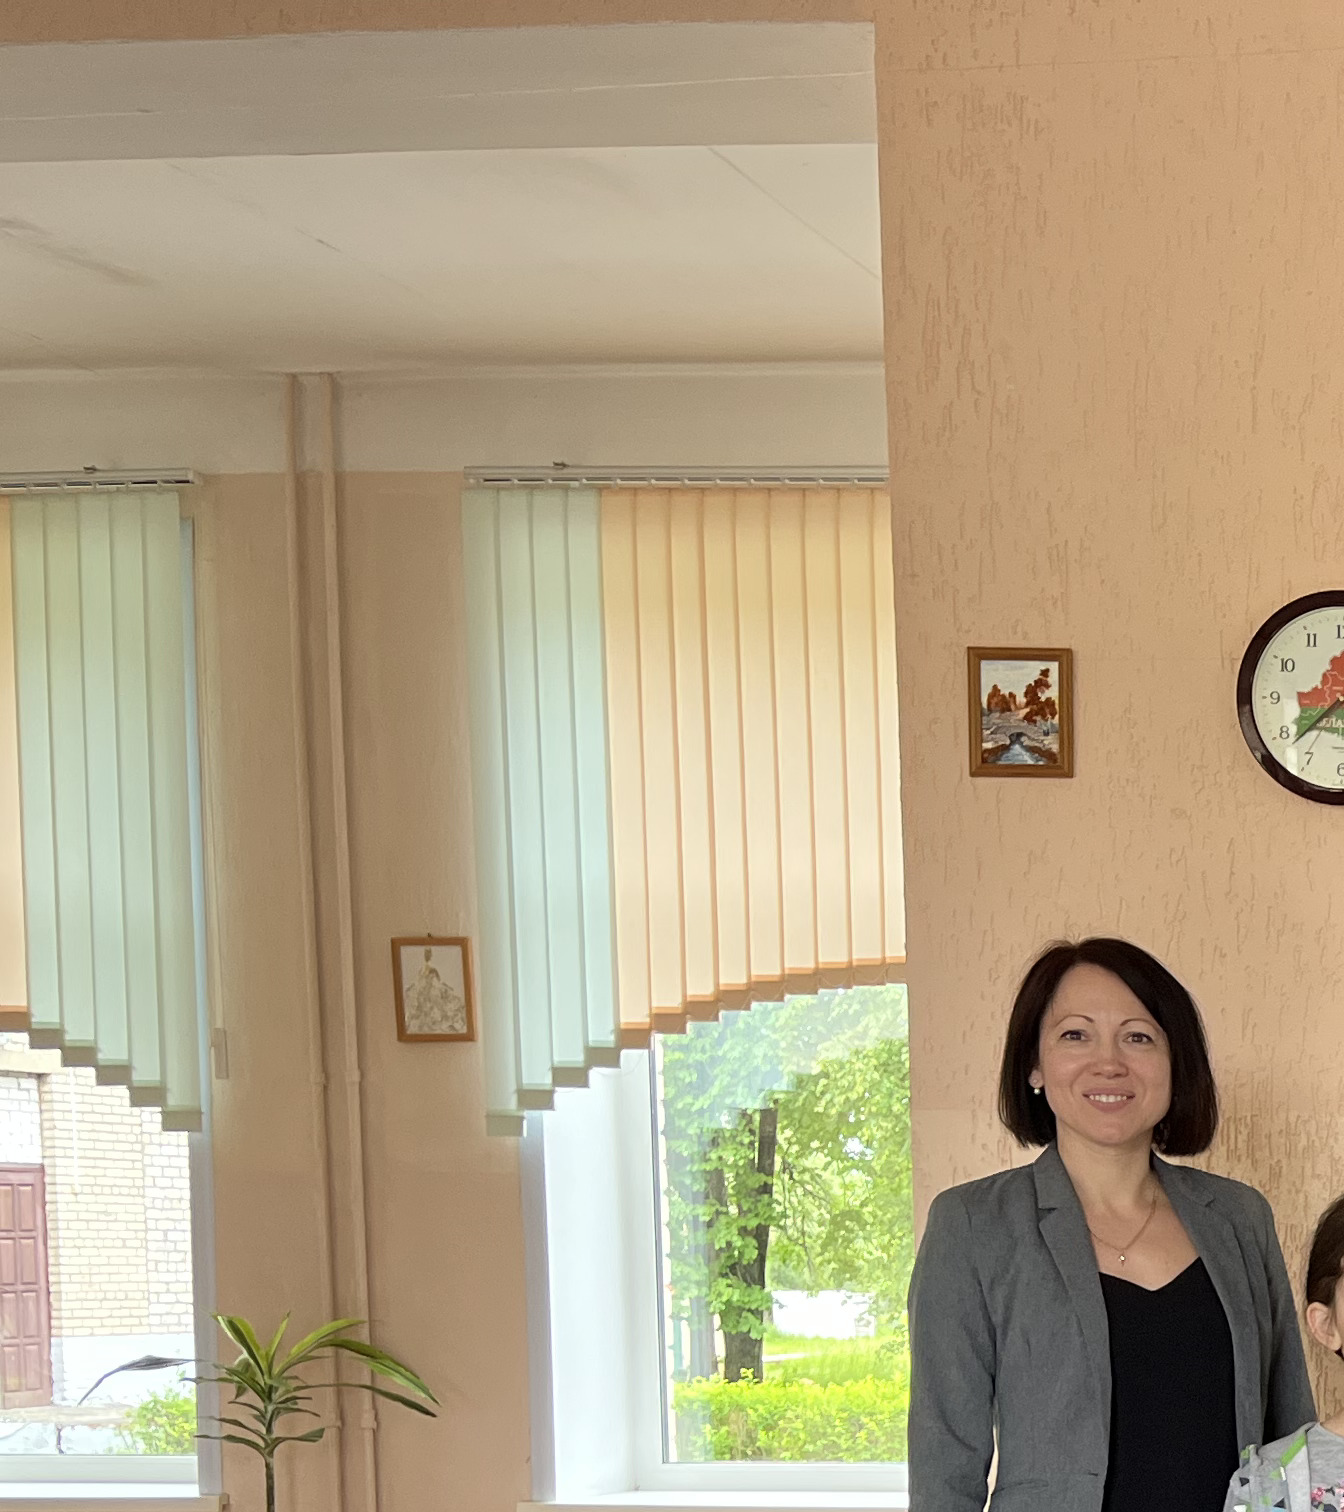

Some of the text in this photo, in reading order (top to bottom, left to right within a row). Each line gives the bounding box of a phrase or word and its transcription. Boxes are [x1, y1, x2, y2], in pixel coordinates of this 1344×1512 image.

[1306, 633, 1317, 648] 11
[1279, 658, 1296, 673] 10
[1269, 691, 1281, 705] 9
[1279, 725, 1290, 740] 8
[1303, 751, 1314, 766] 7
